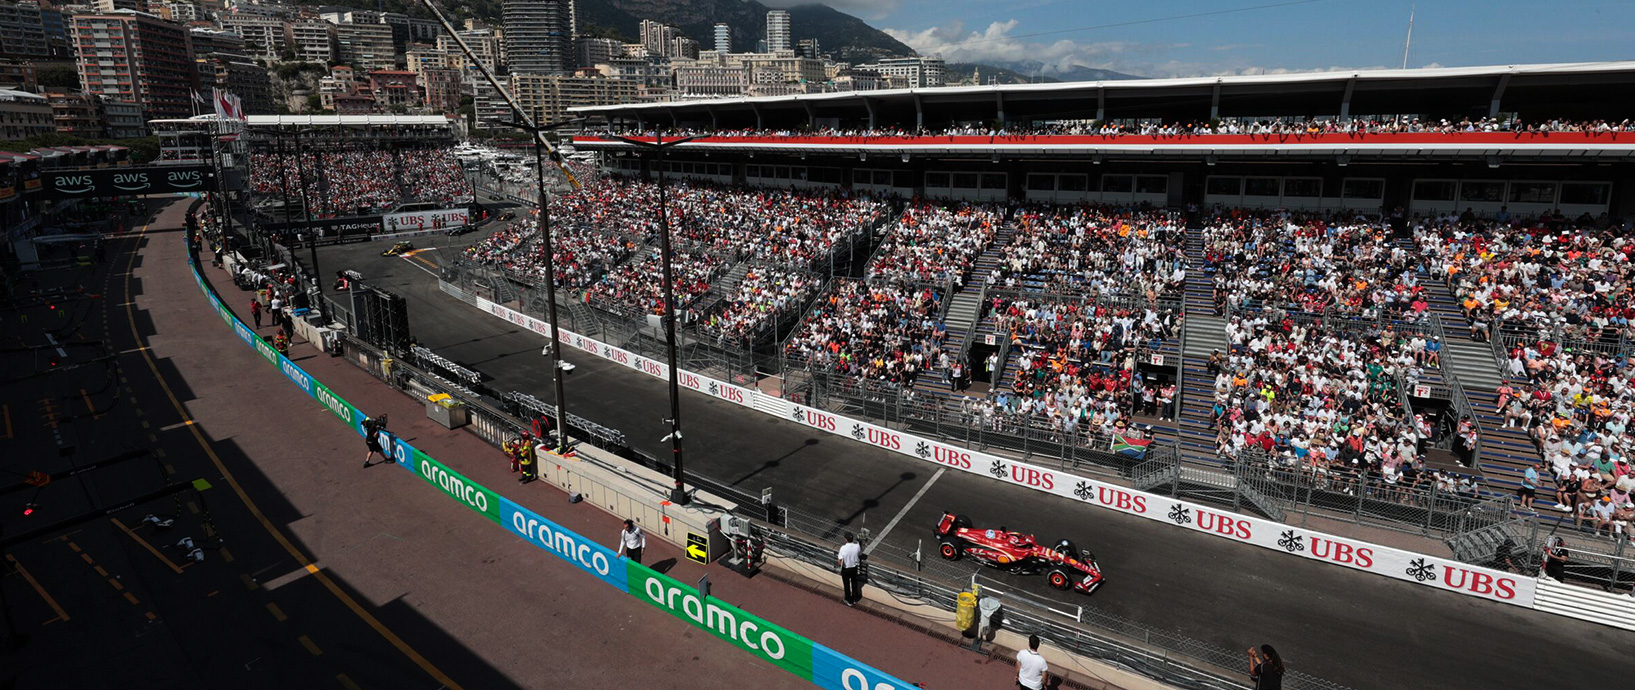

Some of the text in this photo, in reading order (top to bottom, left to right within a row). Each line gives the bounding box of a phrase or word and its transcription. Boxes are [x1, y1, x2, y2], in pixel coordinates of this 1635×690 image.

[55, 175, 93, 186] aws
[114, 172, 149, 184] aws
[167, 171, 200, 181] aws
[400, 215, 425, 226] UBS
[513, 313, 525, 326] UBS
[533, 321, 546, 334] UBS
[583, 339, 598, 353] UBS
[611, 349, 628, 364] UBS
[282, 360, 310, 390] aramco
[642, 361, 662, 377] UBS
[679, 372, 700, 389] UBS
[719, 384, 744, 403] UBS
[316, 386, 351, 423] aramco
[806, 410, 836, 431] UBS
[868, 428, 901, 450] UBS
[933, 445, 971, 469] UBS
[421, 459, 488, 512] aramco
[1010, 464, 1054, 490] UBS
[1097, 486, 1147, 513] UBS
[1195, 509, 1252, 540] UBS
[513, 511, 609, 575] aramco
[1309, 536, 1374, 568] UBS
[1442, 565, 1516, 600] UBS
[645, 577, 785, 660] aramco
